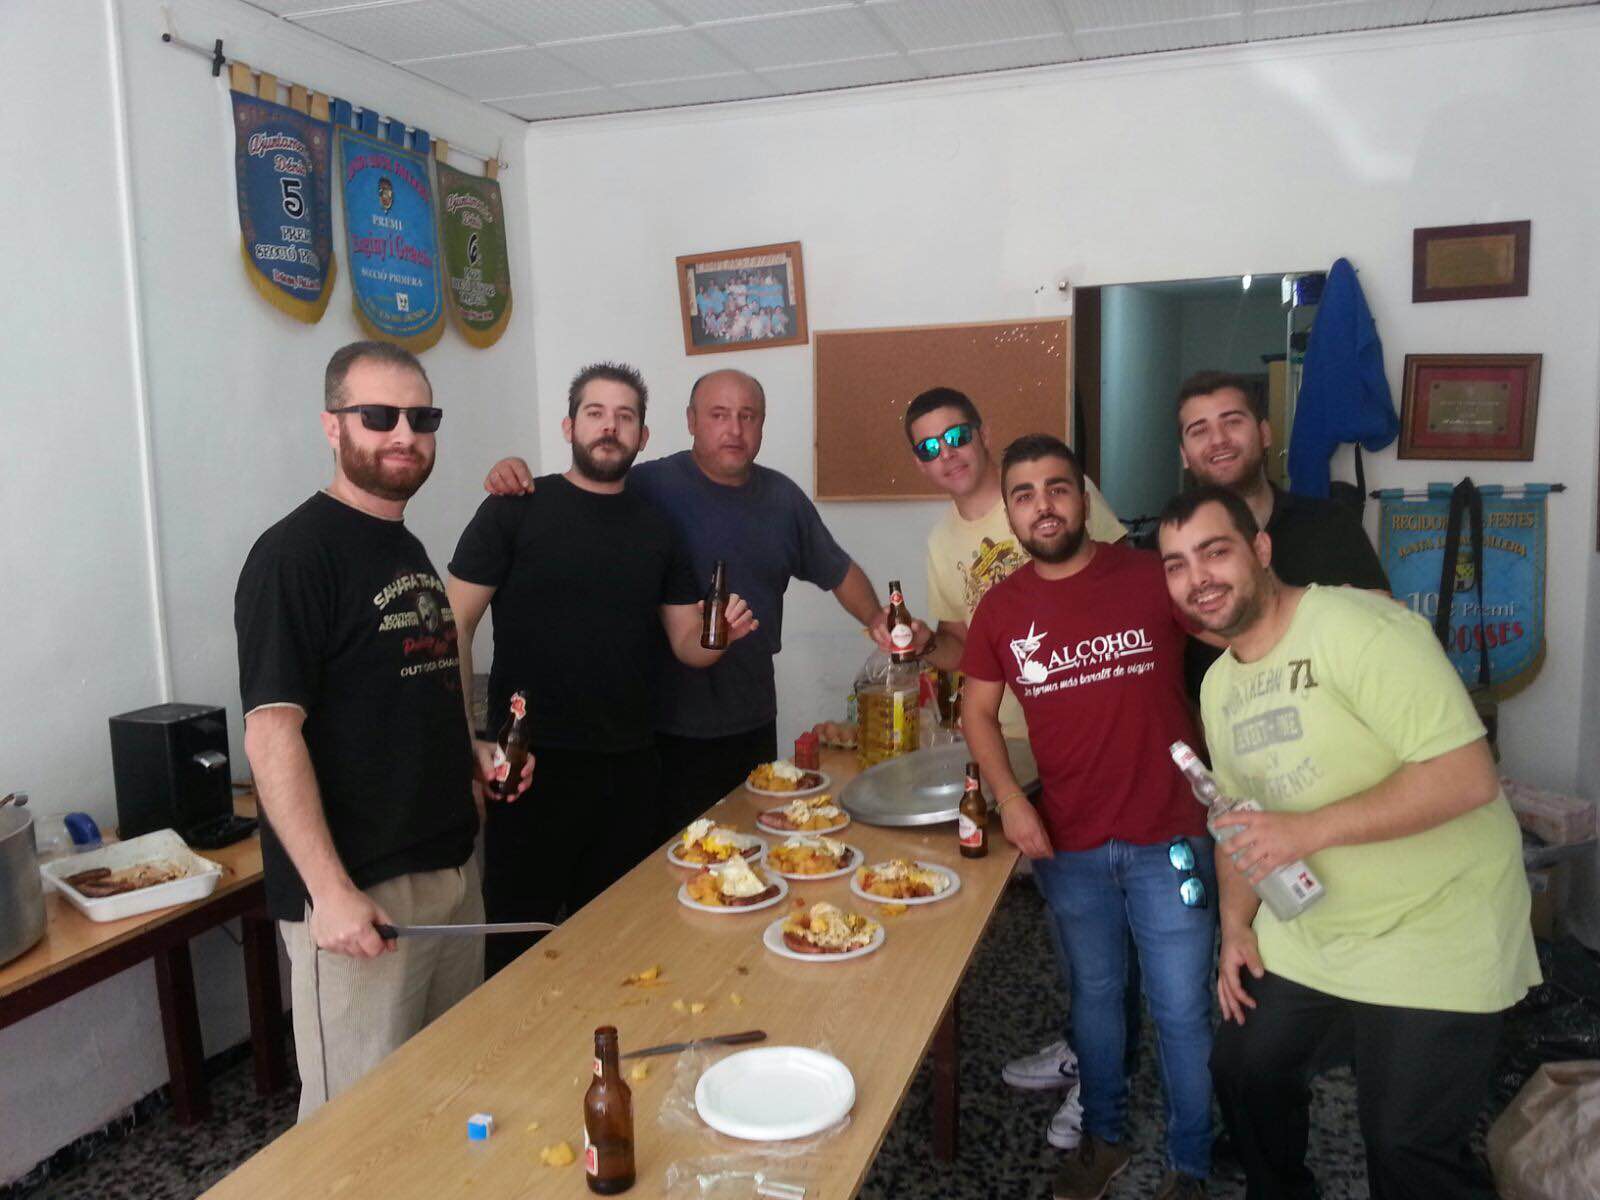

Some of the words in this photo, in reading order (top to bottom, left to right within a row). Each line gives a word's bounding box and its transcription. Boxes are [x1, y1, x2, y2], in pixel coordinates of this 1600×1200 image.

[1048, 628, 1153, 669] ALCOHOL
[1113, 664, 1125, 678] de
[1287, 658, 1319, 694] 71
